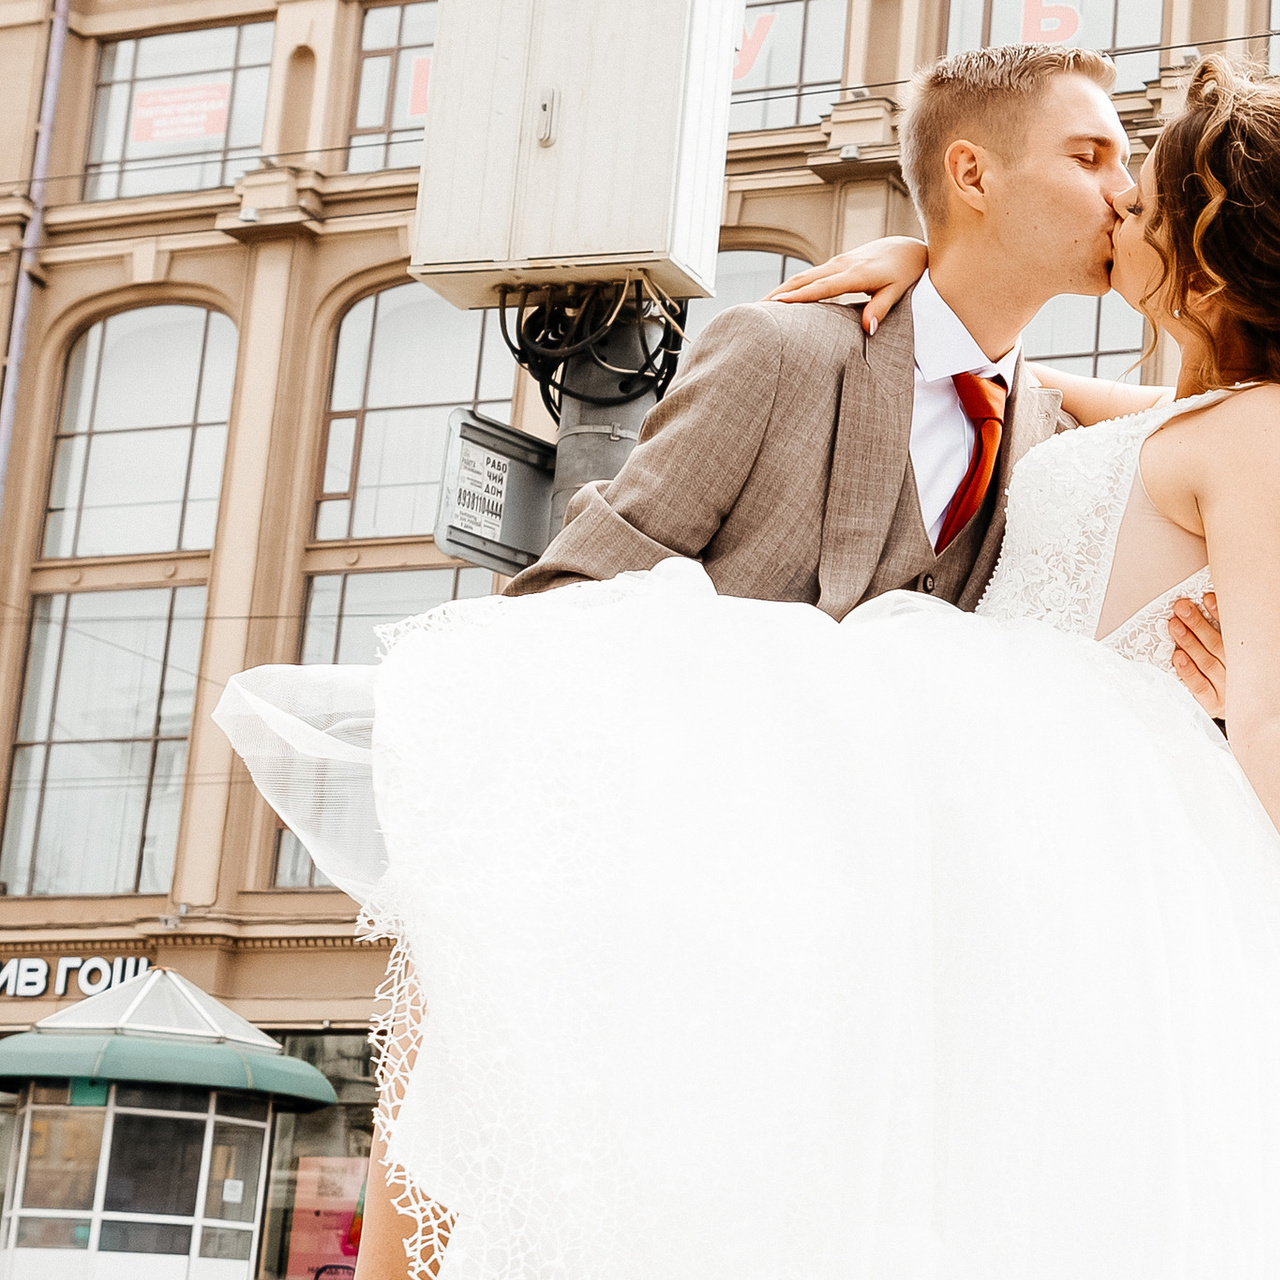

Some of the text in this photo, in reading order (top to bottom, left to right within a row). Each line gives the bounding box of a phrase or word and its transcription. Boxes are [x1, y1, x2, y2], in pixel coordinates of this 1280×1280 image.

[485, 456, 508, 474] РАБО
[486, 470, 503, 486] ЧИЙ
[484, 483, 503, 499] ДОМ
